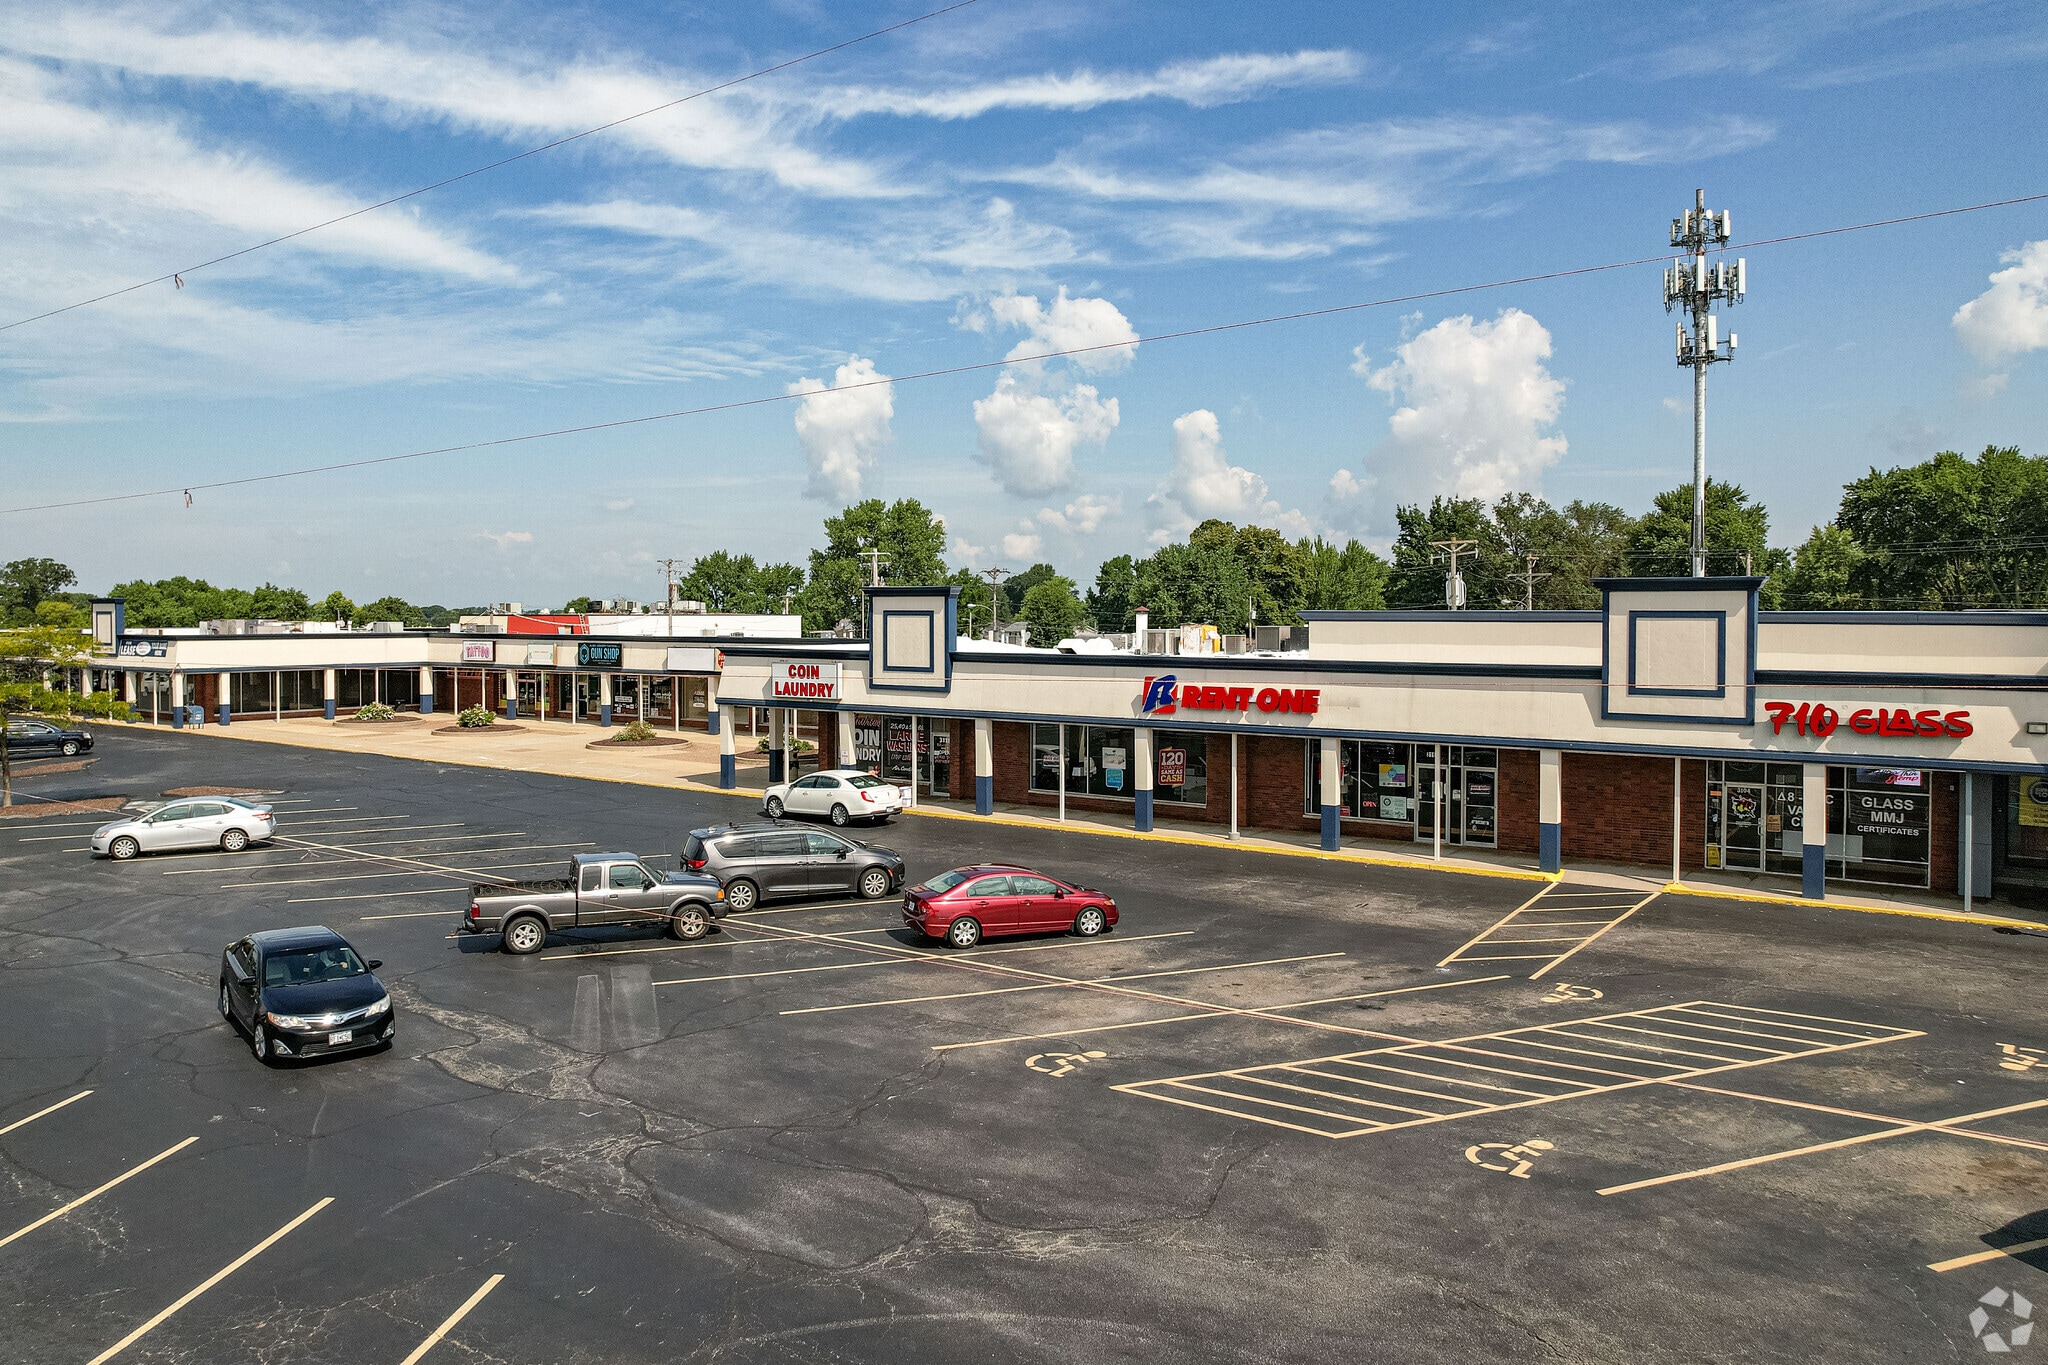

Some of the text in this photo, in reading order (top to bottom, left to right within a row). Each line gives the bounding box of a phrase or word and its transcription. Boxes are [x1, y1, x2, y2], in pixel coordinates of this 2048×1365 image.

[121, 645, 136, 655] LEASE
[466, 646, 490, 659] TATTOO
[591, 648, 619, 660] GUN SHOP
[788, 665, 820, 679] COIN
[775, 682, 834, 697] LAUNDRY
[1181, 686, 1320, 713] RENT ONE
[1765, 702, 1973, 738] 710 GLASS
[855, 729, 879, 746] OIN
[890, 730, 925, 742] LARE
[856, 748, 881, 761] NDRY
[1161, 752, 1184, 765] 120
[1161, 774, 1183, 782] CASH
[1861, 797, 1914, 810] GLASS
[1871, 811, 1904, 823] MMJ
[1857, 825, 1919, 836] CERTIFICATES
